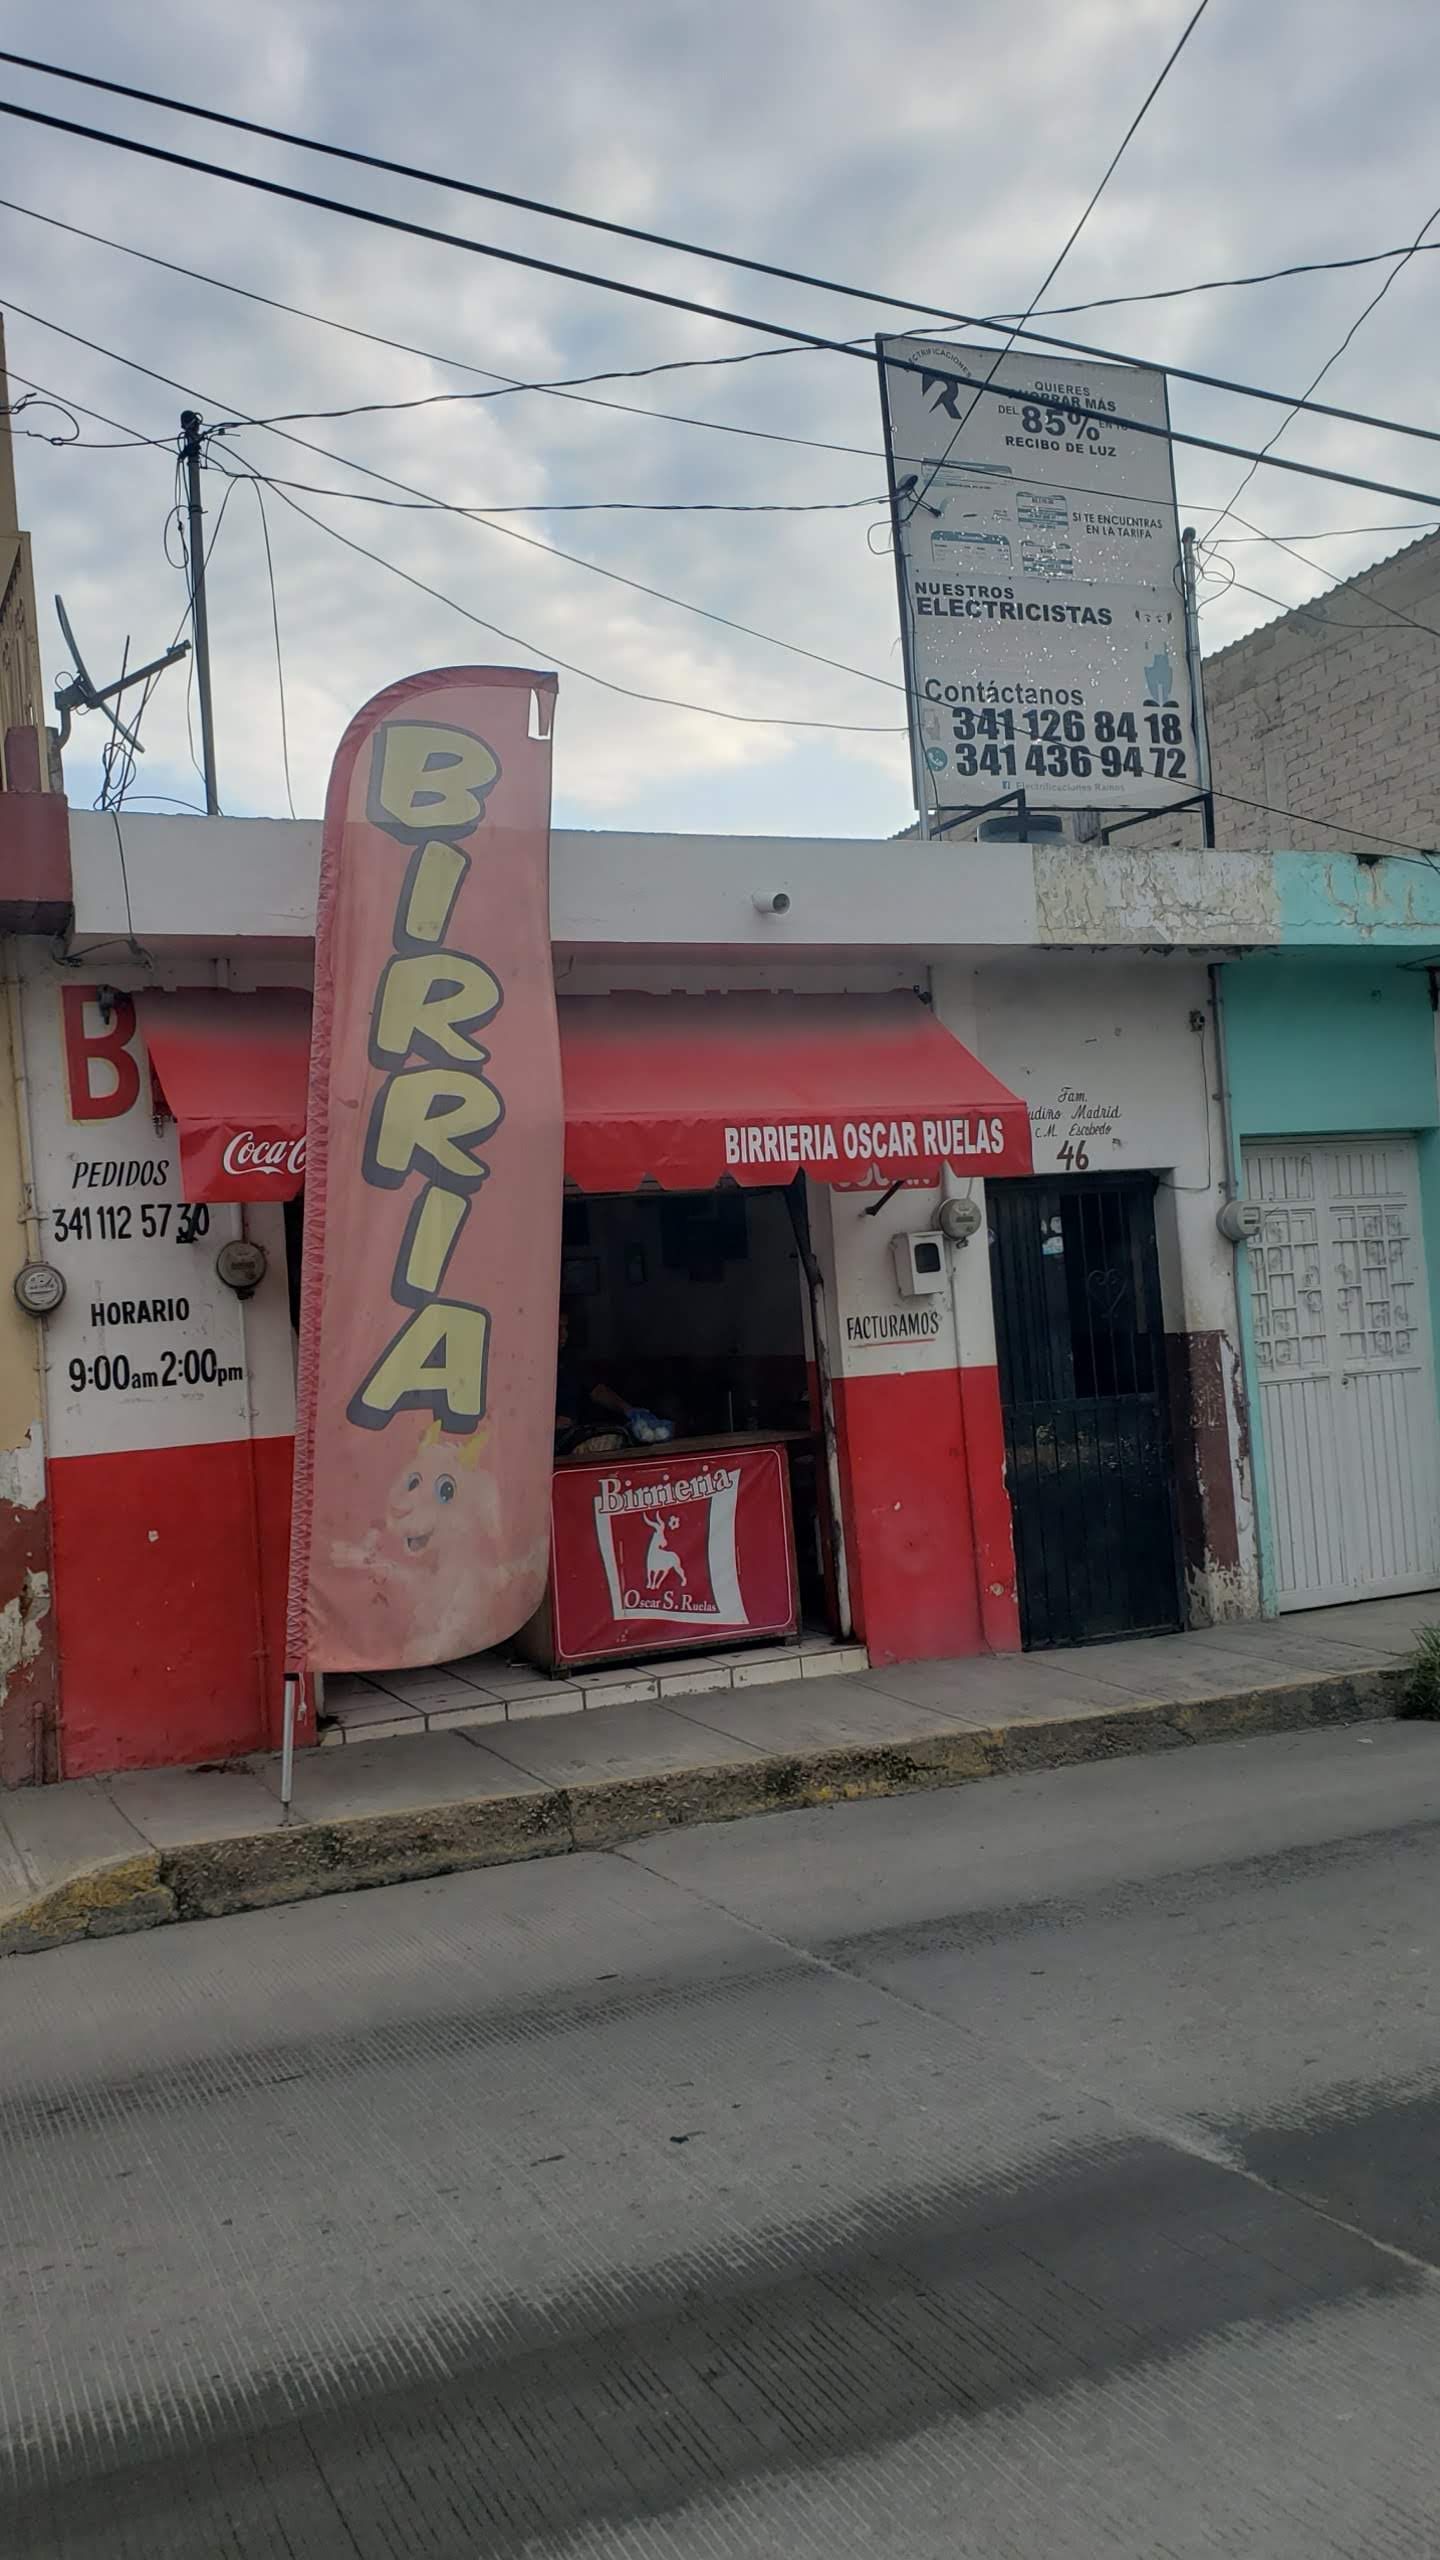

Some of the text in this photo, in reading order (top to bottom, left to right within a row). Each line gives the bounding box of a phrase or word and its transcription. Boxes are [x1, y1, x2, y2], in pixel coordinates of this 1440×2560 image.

[1035, 380, 1090, 397] QUIERES
[1085, 397, 1117, 412] MÁS
[998, 404, 1020, 416] DEL
[1022, 405, 1101, 442] 85%
[1005, 435, 1117, 457] RECIBO DE LUZ
[1072, 512, 1163, 529] SI TE ENCUENTRAS
[1086, 525, 1153, 539] EN LA TARIFA
[914, 581, 1015, 600] NUESTROS
[916, 597, 1113, 625] ELECTRICISTAS
[924, 678, 1085, 706] Contáctanos
[952, 707, 1183, 745] 341 126 84 18
[955, 743, 1187, 778] 341 436 94 72
[347, 720, 503, 1434] BIRRIA
[1057, 1087, 1088, 1103] Fam.
[1071, 1104, 1122, 1120] Madrid
[724, 1118, 1005, 1164] BIRRIERIA OSCAR RUELAS
[1068, 1122, 1112, 1137] Escobedo
[1056, 1140, 1090, 1171] 46
[72, 1160, 170, 1189] PEDIDOS
[52, 1206, 92, 1243] 341
[97, 1205, 132, 1240] 112
[141, 1203, 172, 1238] 57
[91, 1297, 190, 1327] HORARIO
[845, 1311, 940, 1341] FACTURAMOS
[598, 1465, 732, 1514] Birrieria
[624, 1589, 717, 1612] Oscar S. Ruelas
